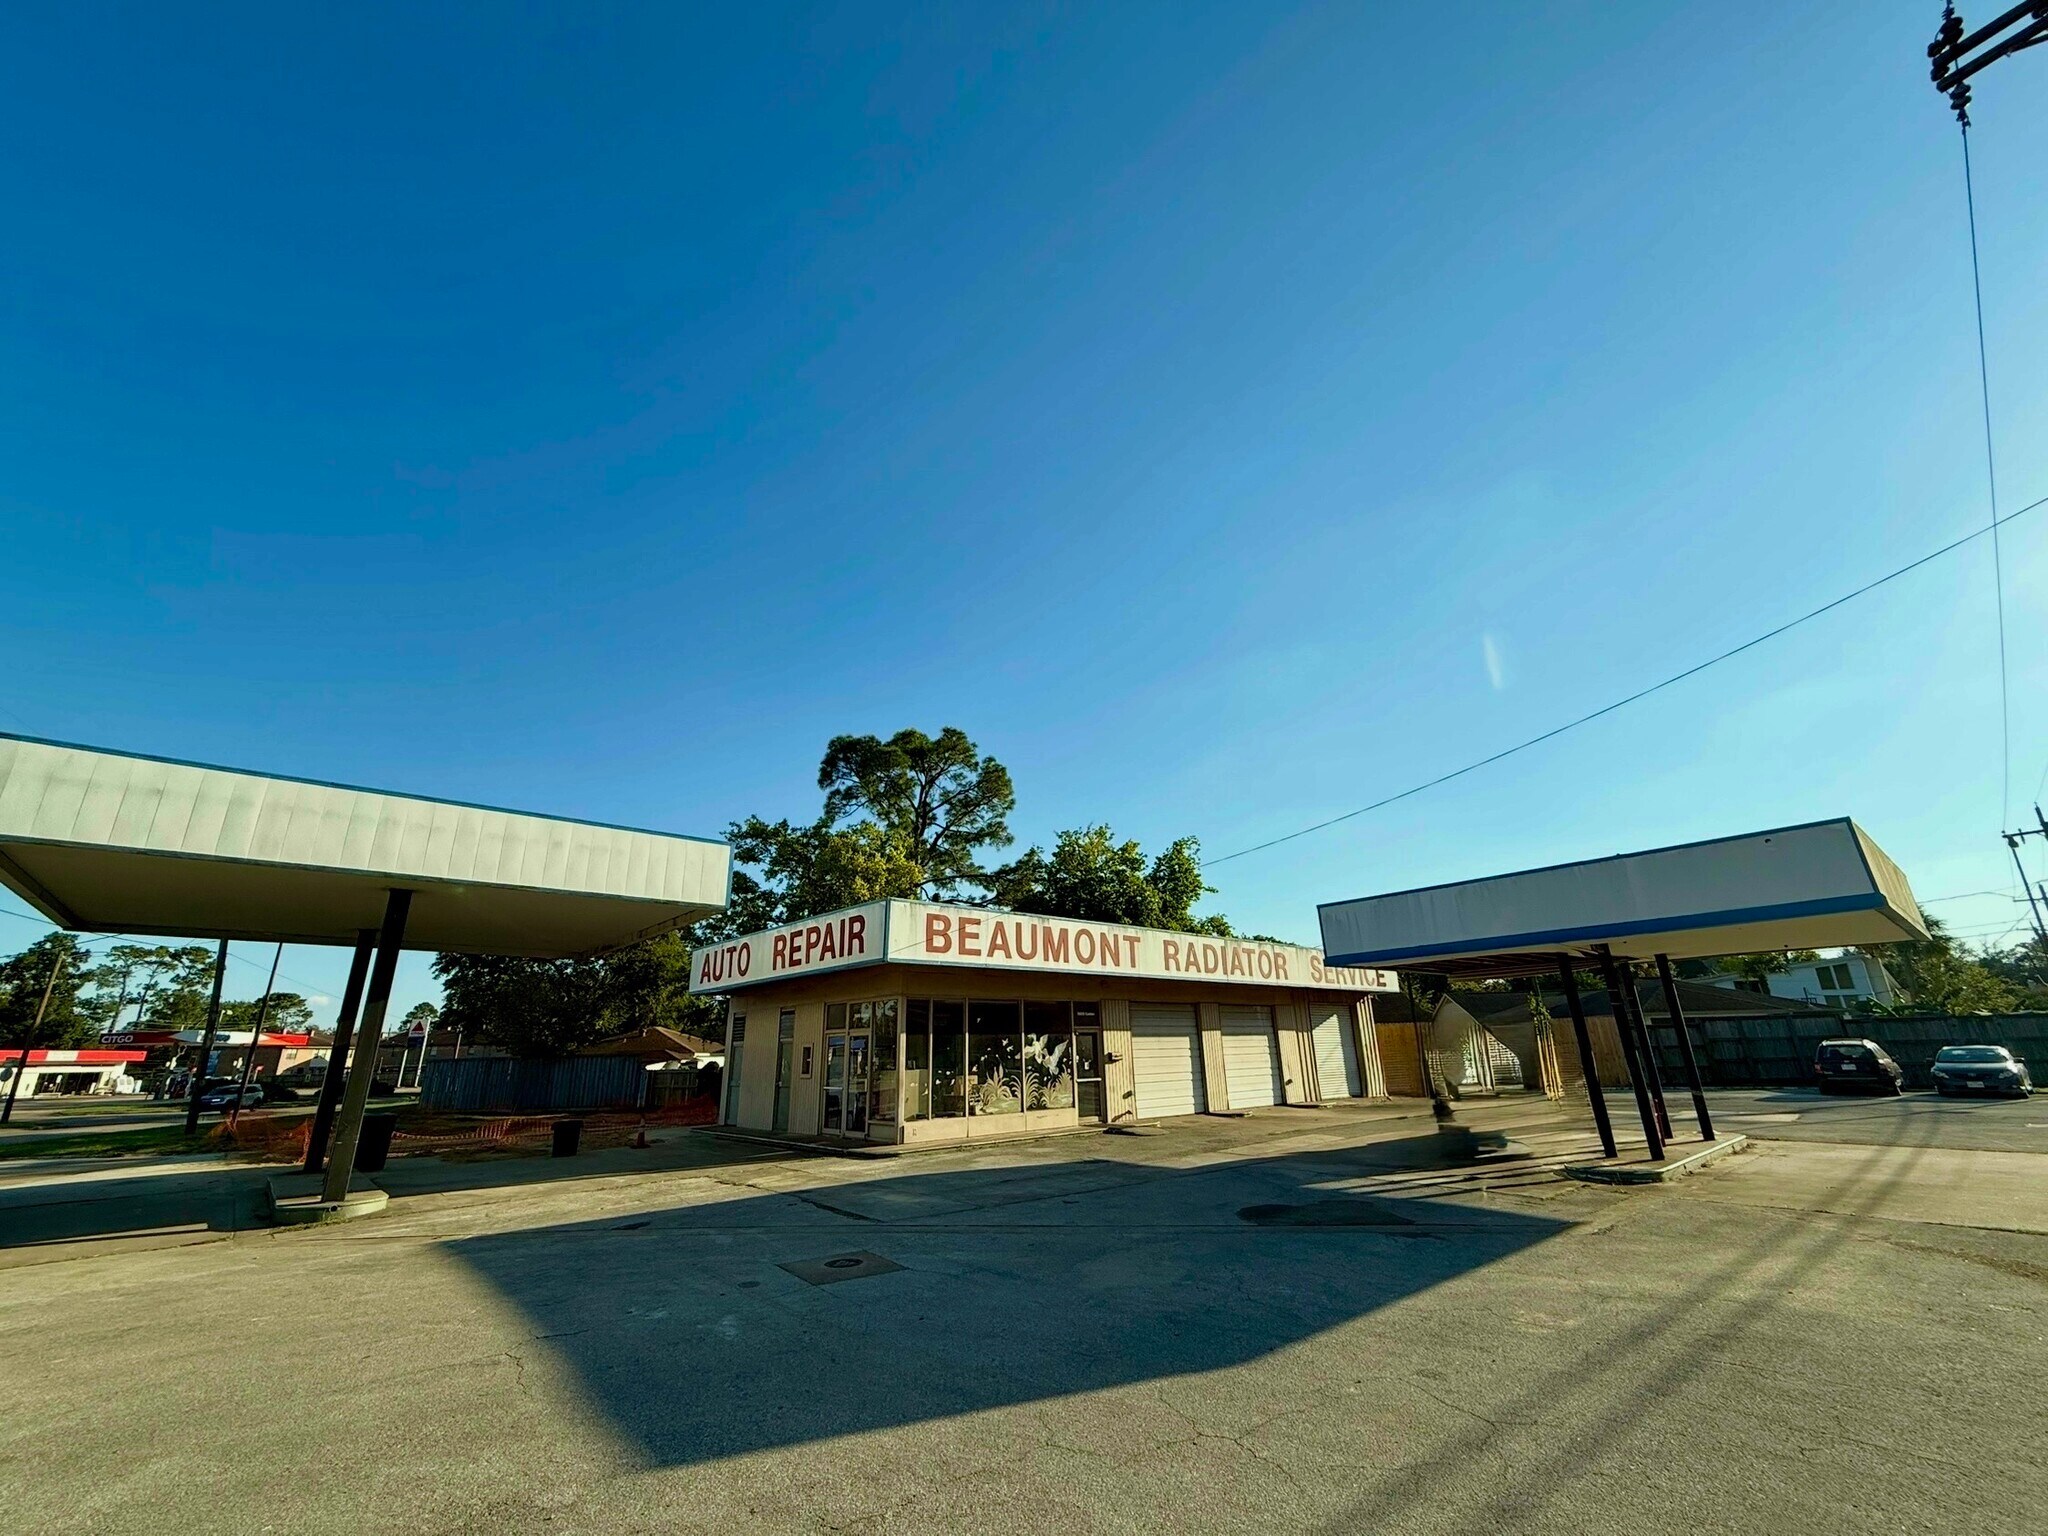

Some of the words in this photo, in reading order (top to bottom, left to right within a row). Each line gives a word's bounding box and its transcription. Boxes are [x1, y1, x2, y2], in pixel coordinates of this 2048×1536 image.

[700, 941, 751, 984] AUTO
[772, 914, 866, 971] REPAIR
[925, 912, 1141, 968] BEAUMONT
[1163, 939, 1289, 980] RADIATOR
[101, 1035, 134, 1044] CITGO
